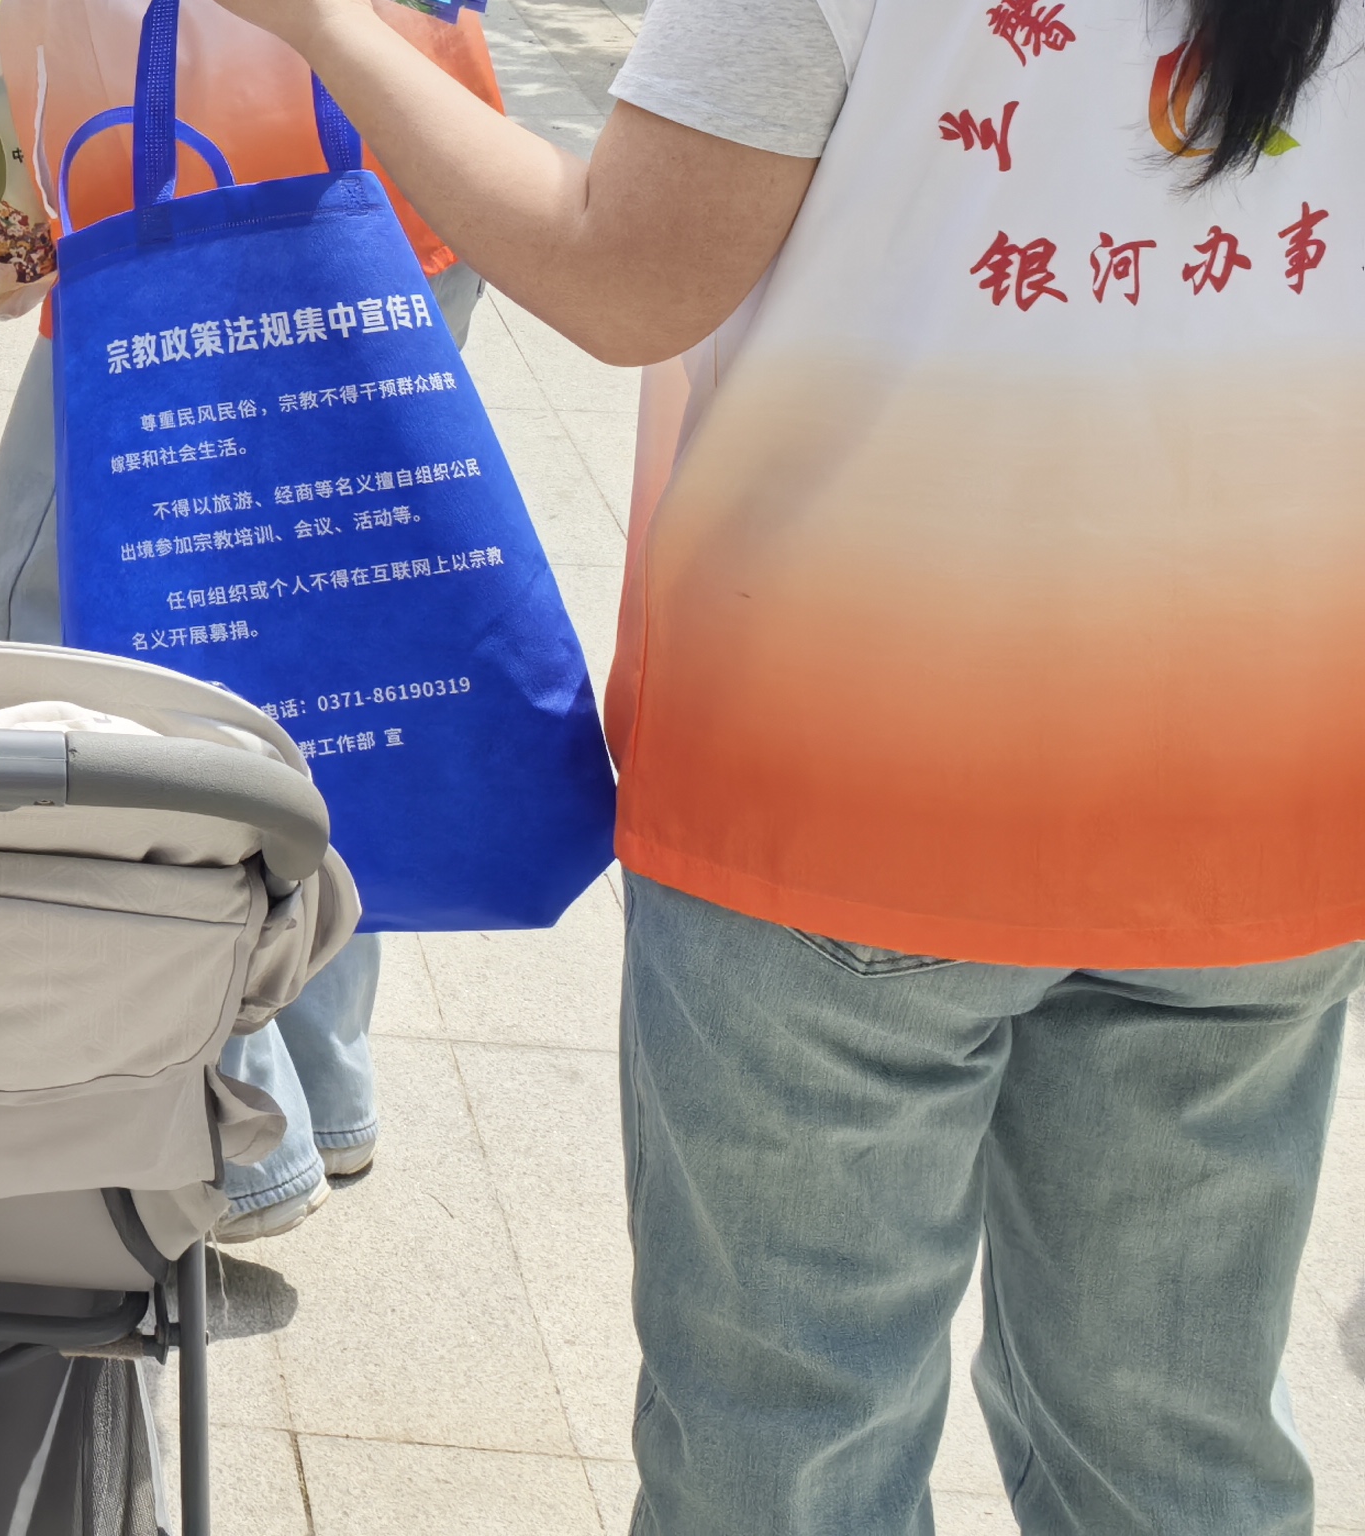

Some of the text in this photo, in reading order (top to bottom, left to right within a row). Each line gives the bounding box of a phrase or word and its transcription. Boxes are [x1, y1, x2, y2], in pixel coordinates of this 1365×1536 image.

[106, 293, 433, 374] 宗教政策法规集中宣传月
[140, 371, 457, 432] 尊重民风民俗，宗教不得干预群众婚丧
[110, 438, 248, 474] 嫁娶和社会生活。
[153, 458, 482, 521] 不得以旅游、经商等名义擅自组织公民
[120, 505, 421, 562] 出境参加宗教培训、会议、活动等。
[166, 546, 504, 611] 任何组织或个人不得在互联网上以宗教
[132, 620, 259, 652] 名义开展募捐。
